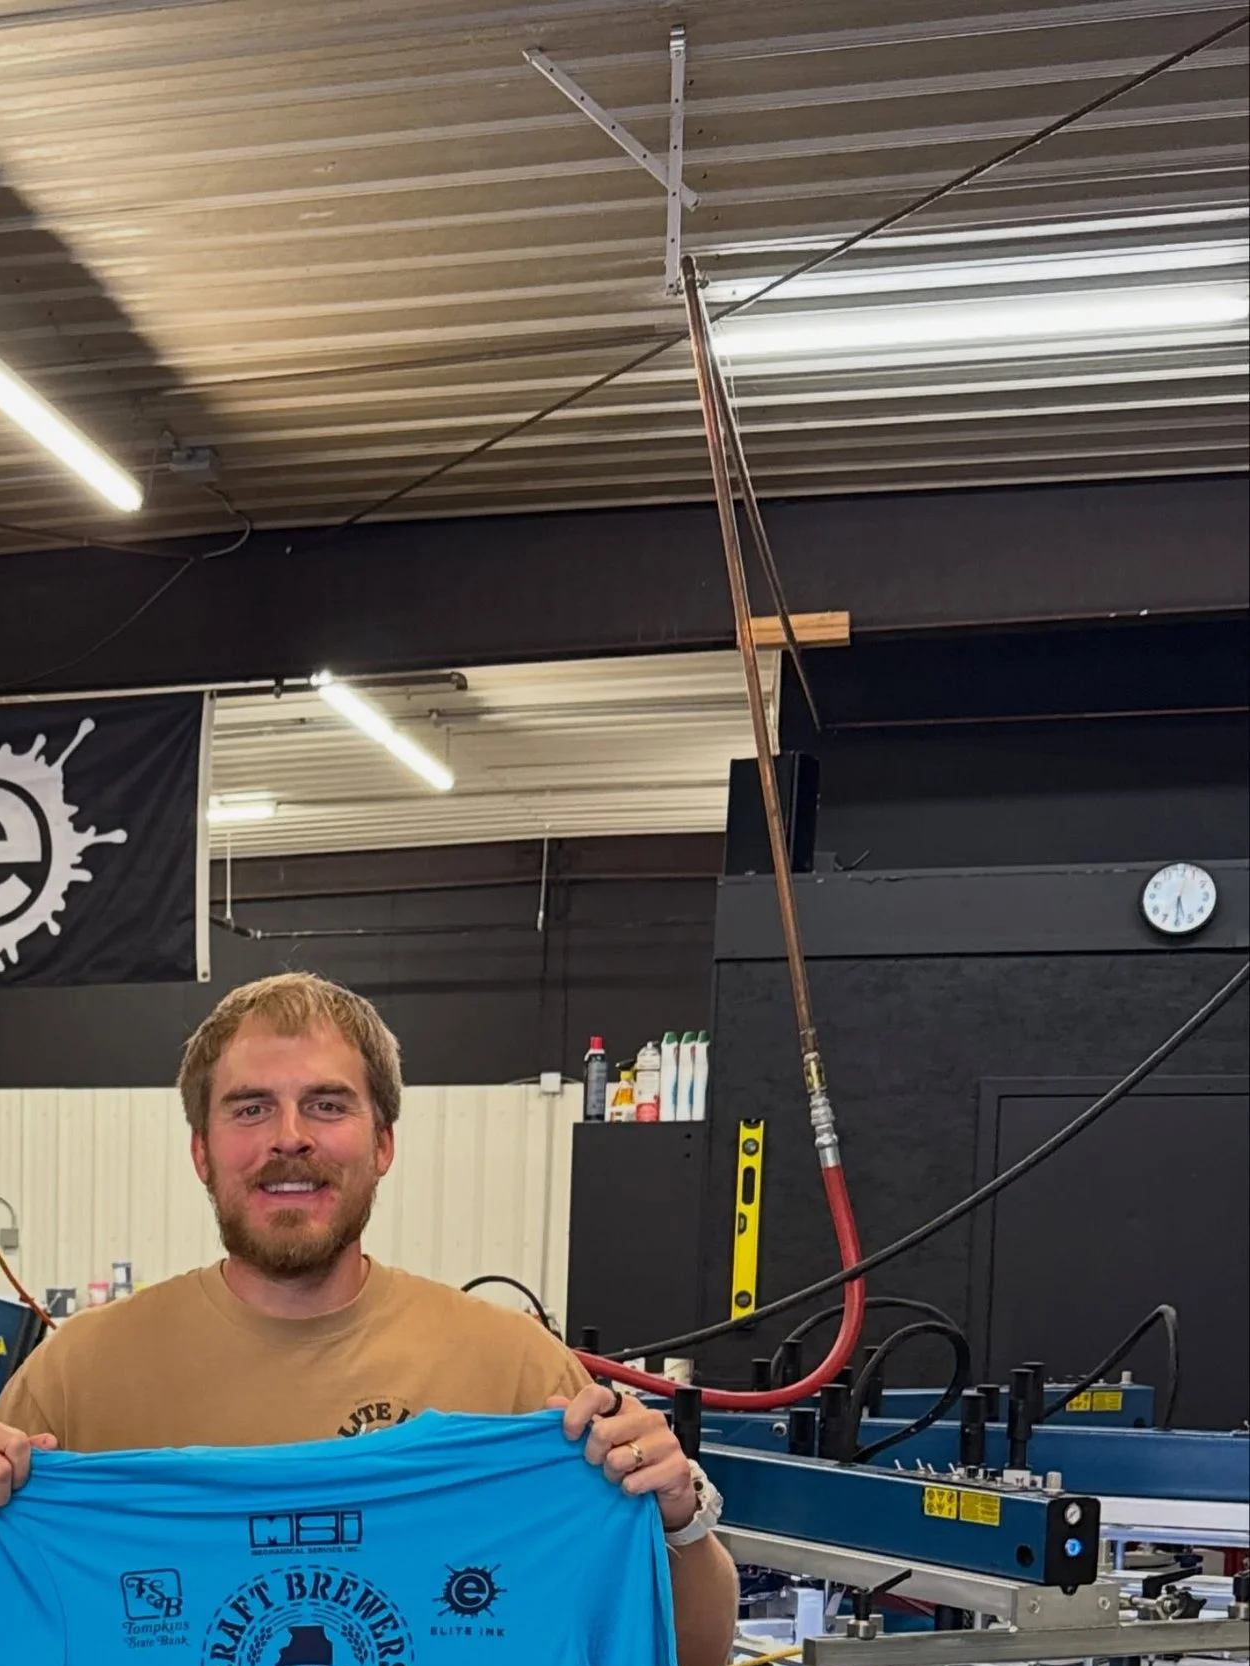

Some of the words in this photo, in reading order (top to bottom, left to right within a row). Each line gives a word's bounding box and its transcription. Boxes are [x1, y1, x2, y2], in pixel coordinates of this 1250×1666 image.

[122, 1620, 190, 1636] Tompkins
[430, 1626, 472, 1636] ELITE
[479, 1627, 505, 1637] INK
